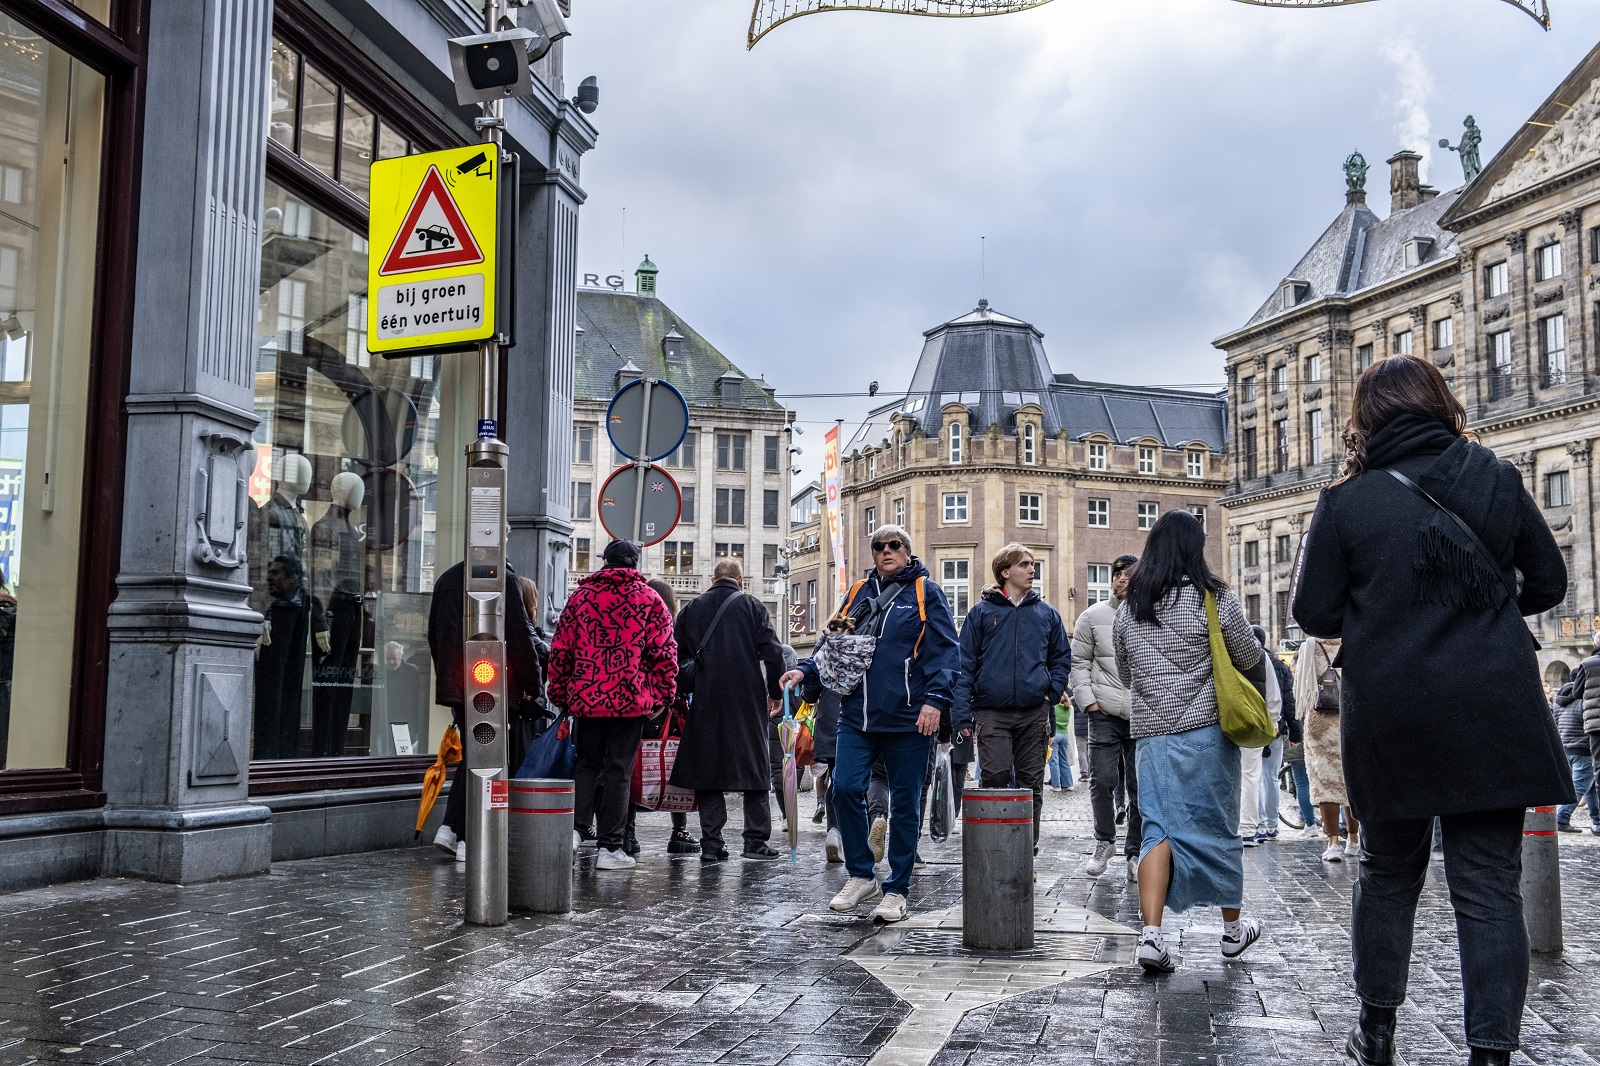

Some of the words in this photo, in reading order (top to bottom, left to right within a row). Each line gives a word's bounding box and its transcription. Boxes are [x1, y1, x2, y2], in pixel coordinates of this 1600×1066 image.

[396, 288, 416, 307] bij
[422, 284, 466, 305] groen
[381, 314, 408, 330] één
[414, 305, 480, 326] voertuig
